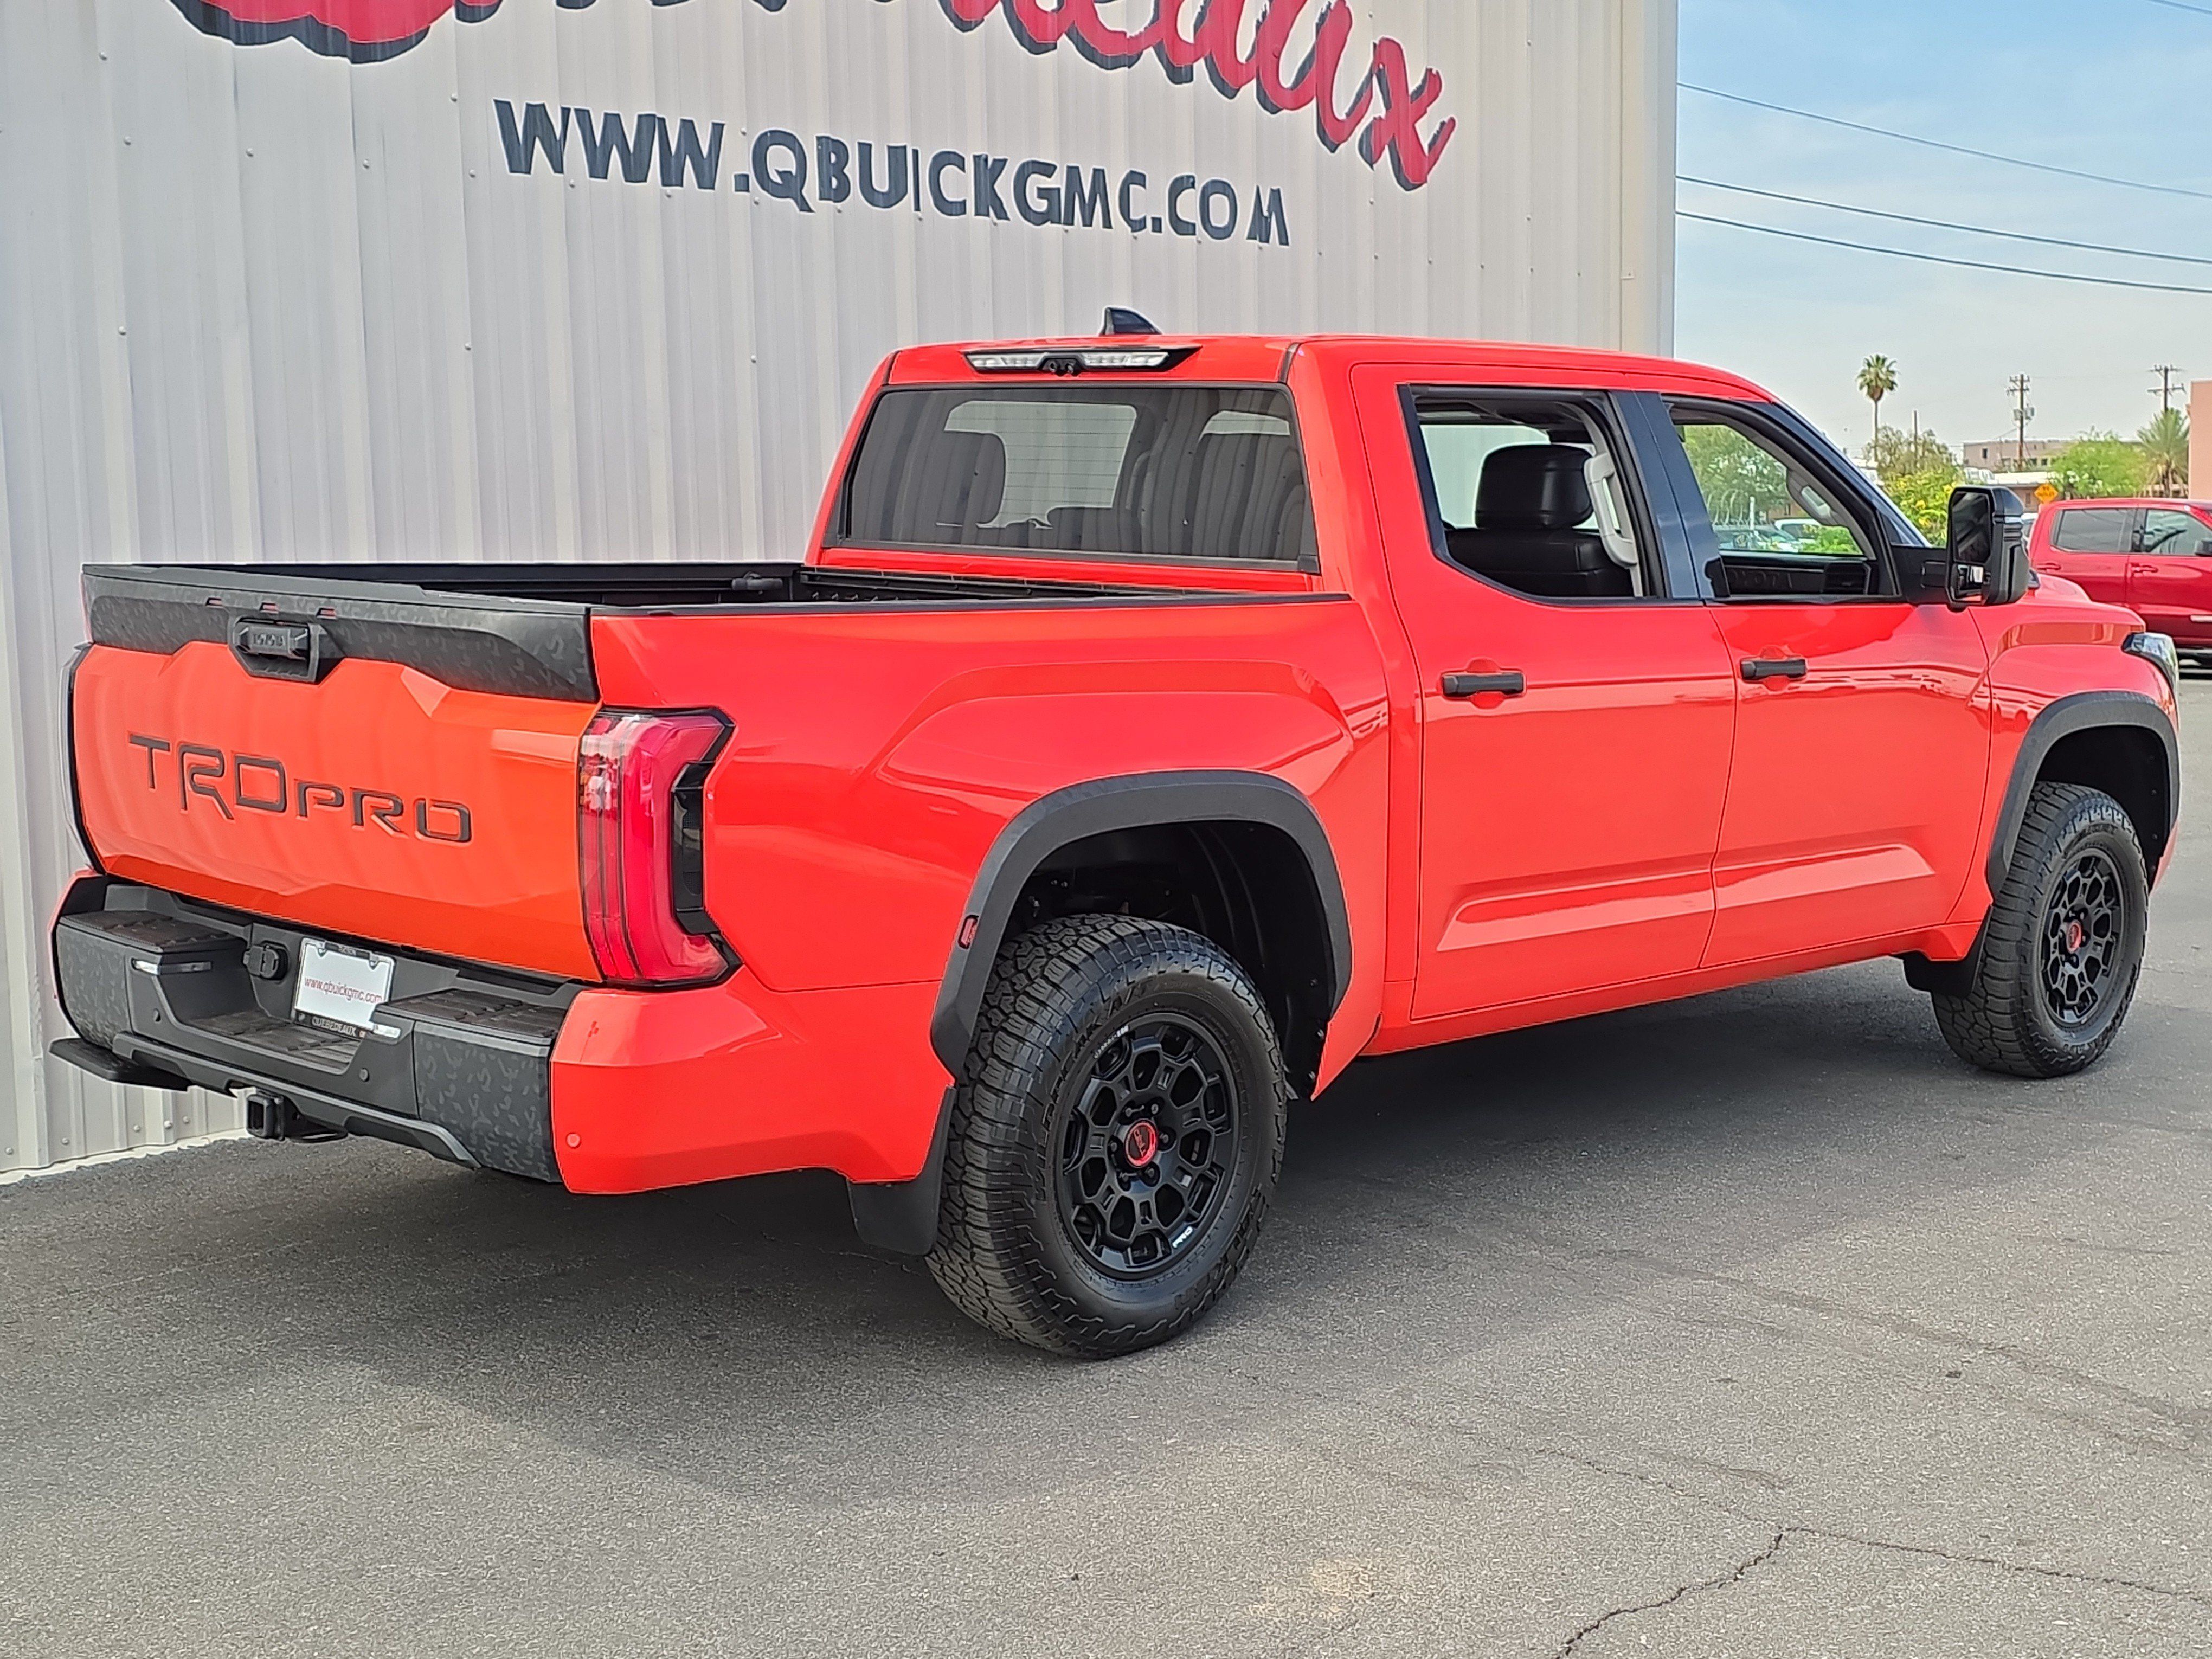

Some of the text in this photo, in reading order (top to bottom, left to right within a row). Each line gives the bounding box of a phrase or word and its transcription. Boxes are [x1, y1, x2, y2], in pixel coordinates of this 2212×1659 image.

[493, 98, 1290, 247] WWW.QBUICKGMC.COM
[129, 733, 472, 843] TRD PRO
